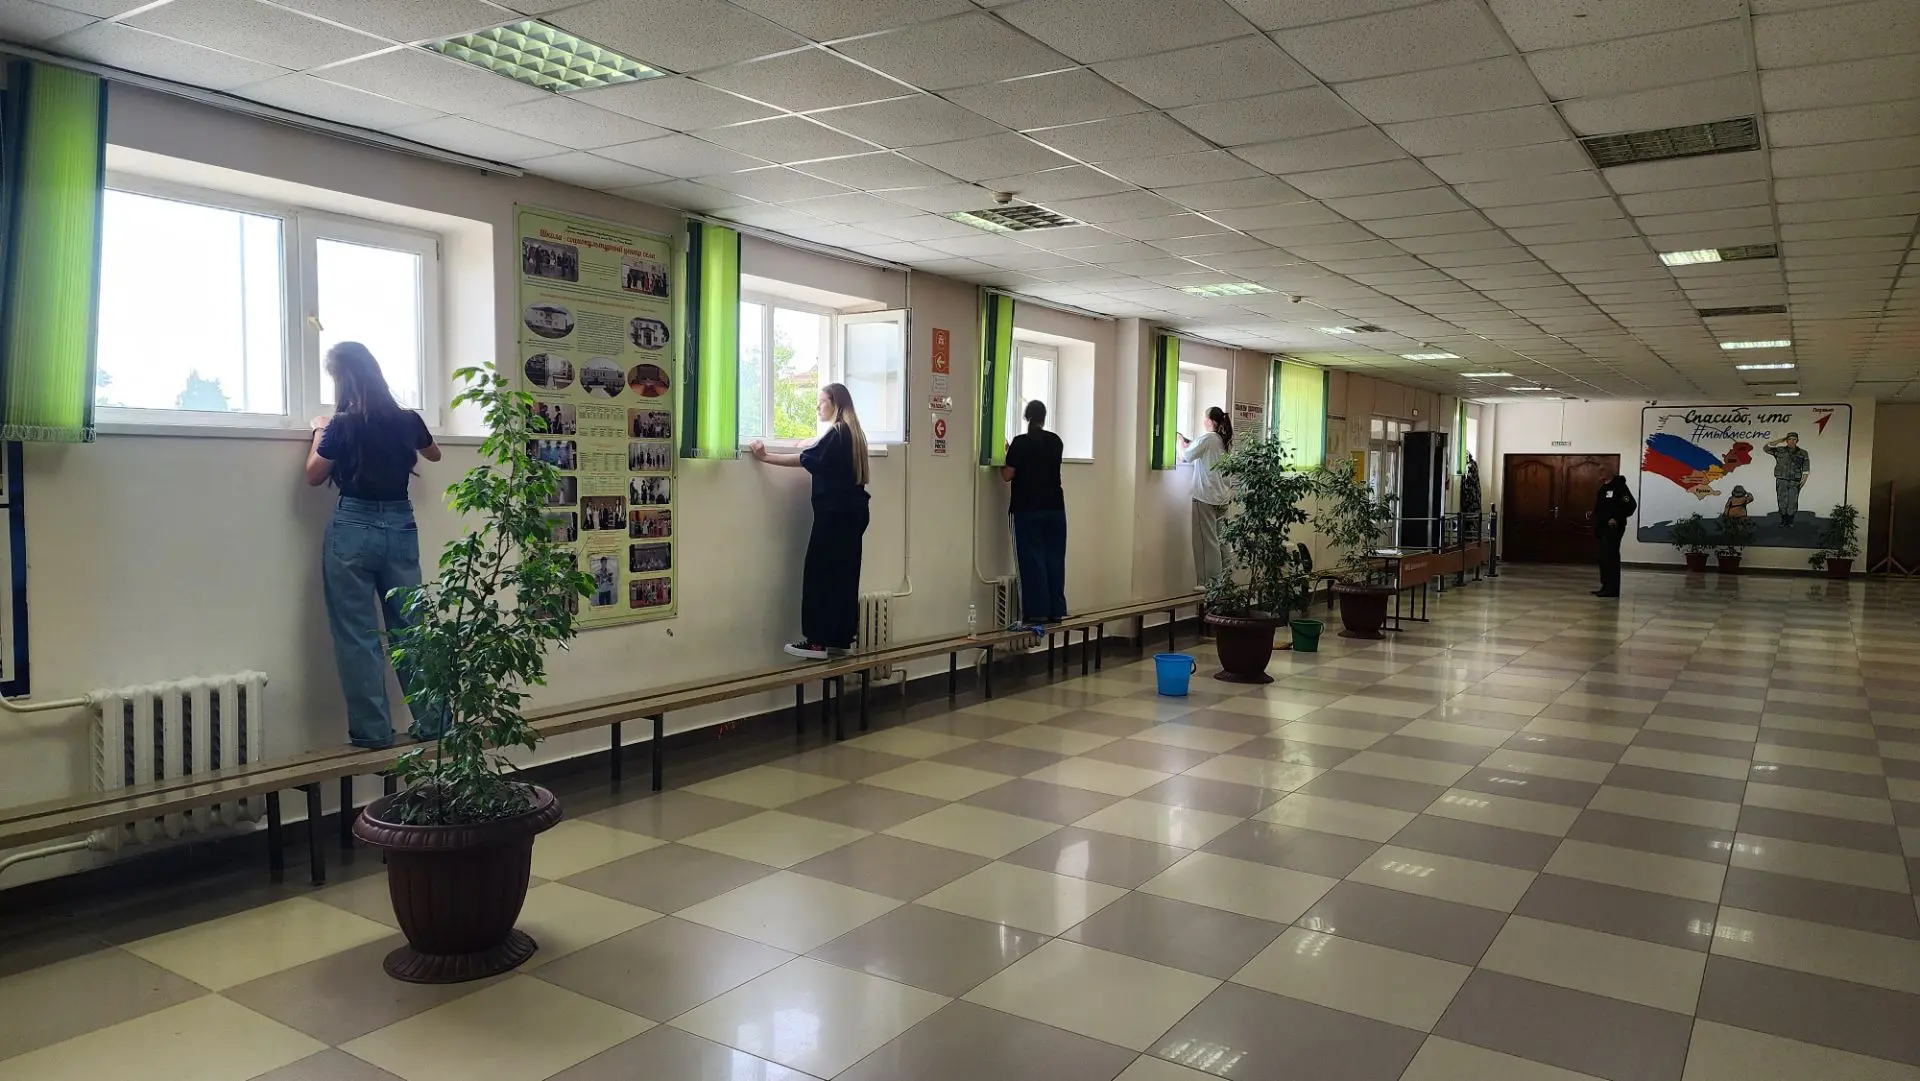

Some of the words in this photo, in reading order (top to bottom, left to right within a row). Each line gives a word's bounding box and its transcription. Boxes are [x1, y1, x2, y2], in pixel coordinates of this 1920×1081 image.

[1684, 407, 1752, 425] Спасибо,
[1757, 412, 1792, 424] что
[1691, 424, 1771, 443] #мывместе
